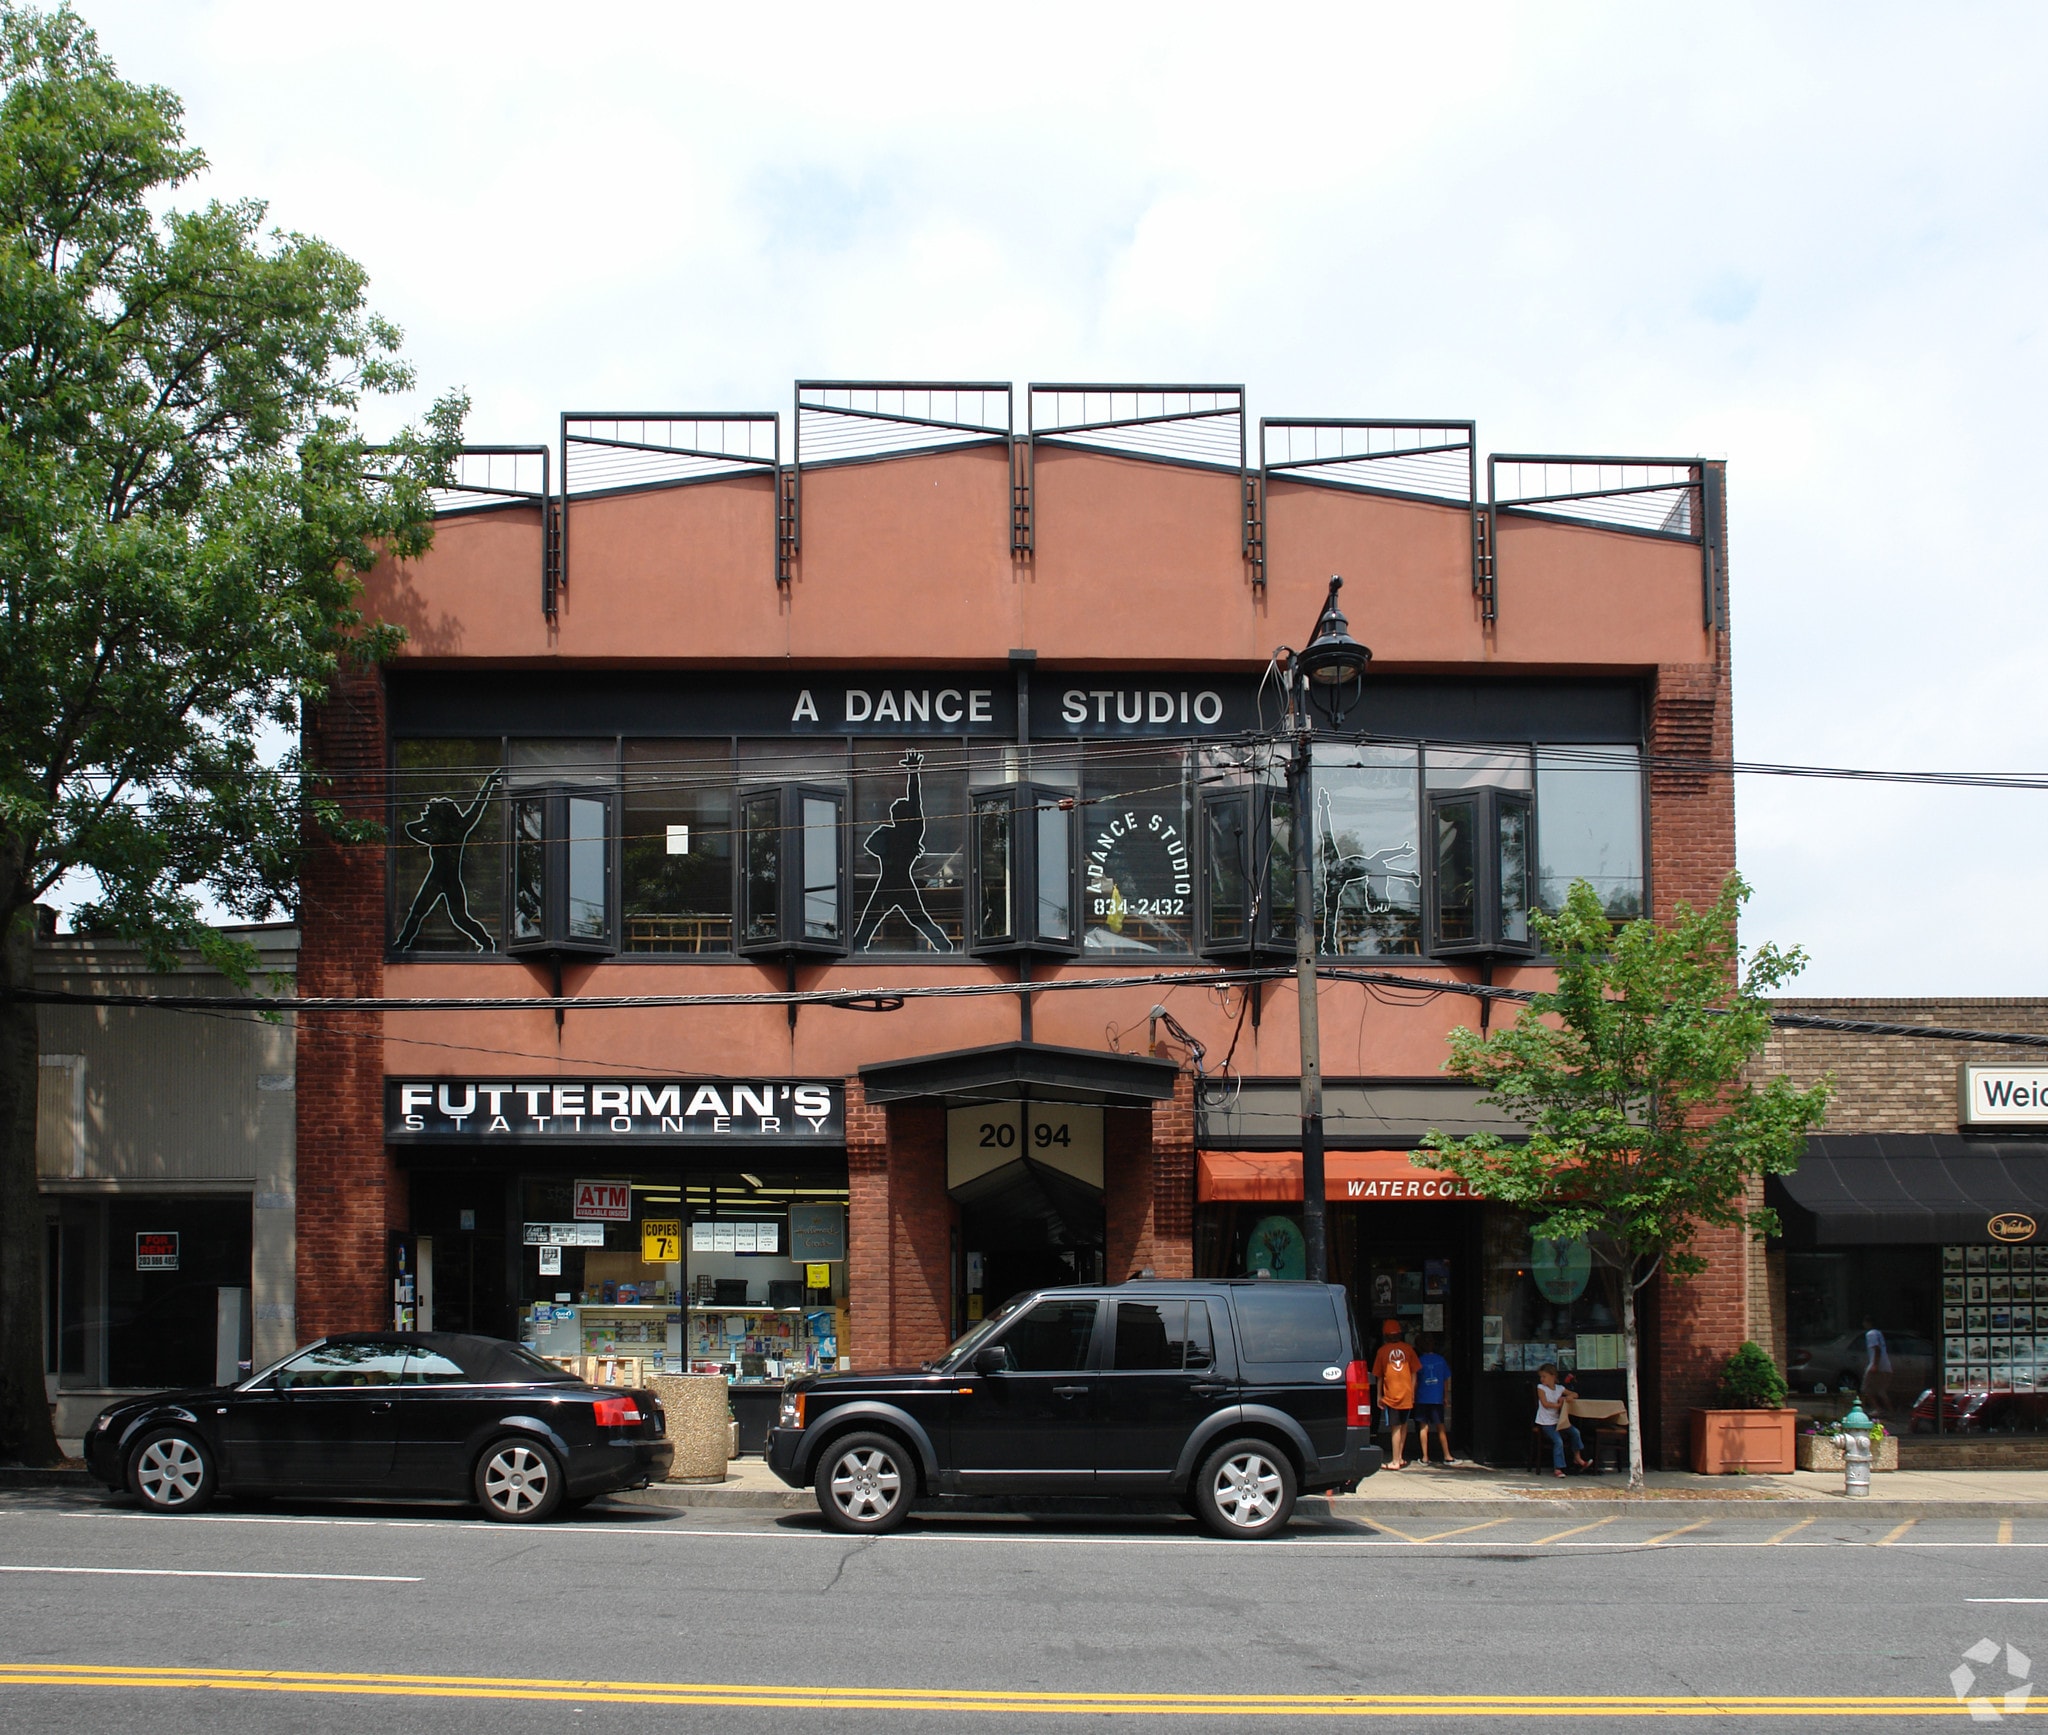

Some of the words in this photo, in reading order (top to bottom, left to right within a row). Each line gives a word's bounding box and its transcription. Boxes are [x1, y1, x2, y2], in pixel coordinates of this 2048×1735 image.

[792, 690, 819, 722] A
[845, 690, 993, 722] DANCE
[1061, 691, 1223, 724] STUDIO
[1148, 814, 1191, 894] STUDIO
[1094, 898, 1184, 915] 834-2432
[401, 1083, 831, 1116] FUTTERMAN'S
[405, 1115, 828, 1133] STATIONERY
[979, 1123, 1015, 1148] 20
[1034, 1123, 1071, 1148] 94
[579, 1186, 627, 1206] ATM
[1347, 1180, 1480, 1197] WATERCOLO
[577, 1208, 607, 1217] AVAILABLE
[646, 1223, 678, 1236] COPIES
[145, 1235, 169, 1244] FOR
[140, 1245, 175, 1255] RENT
